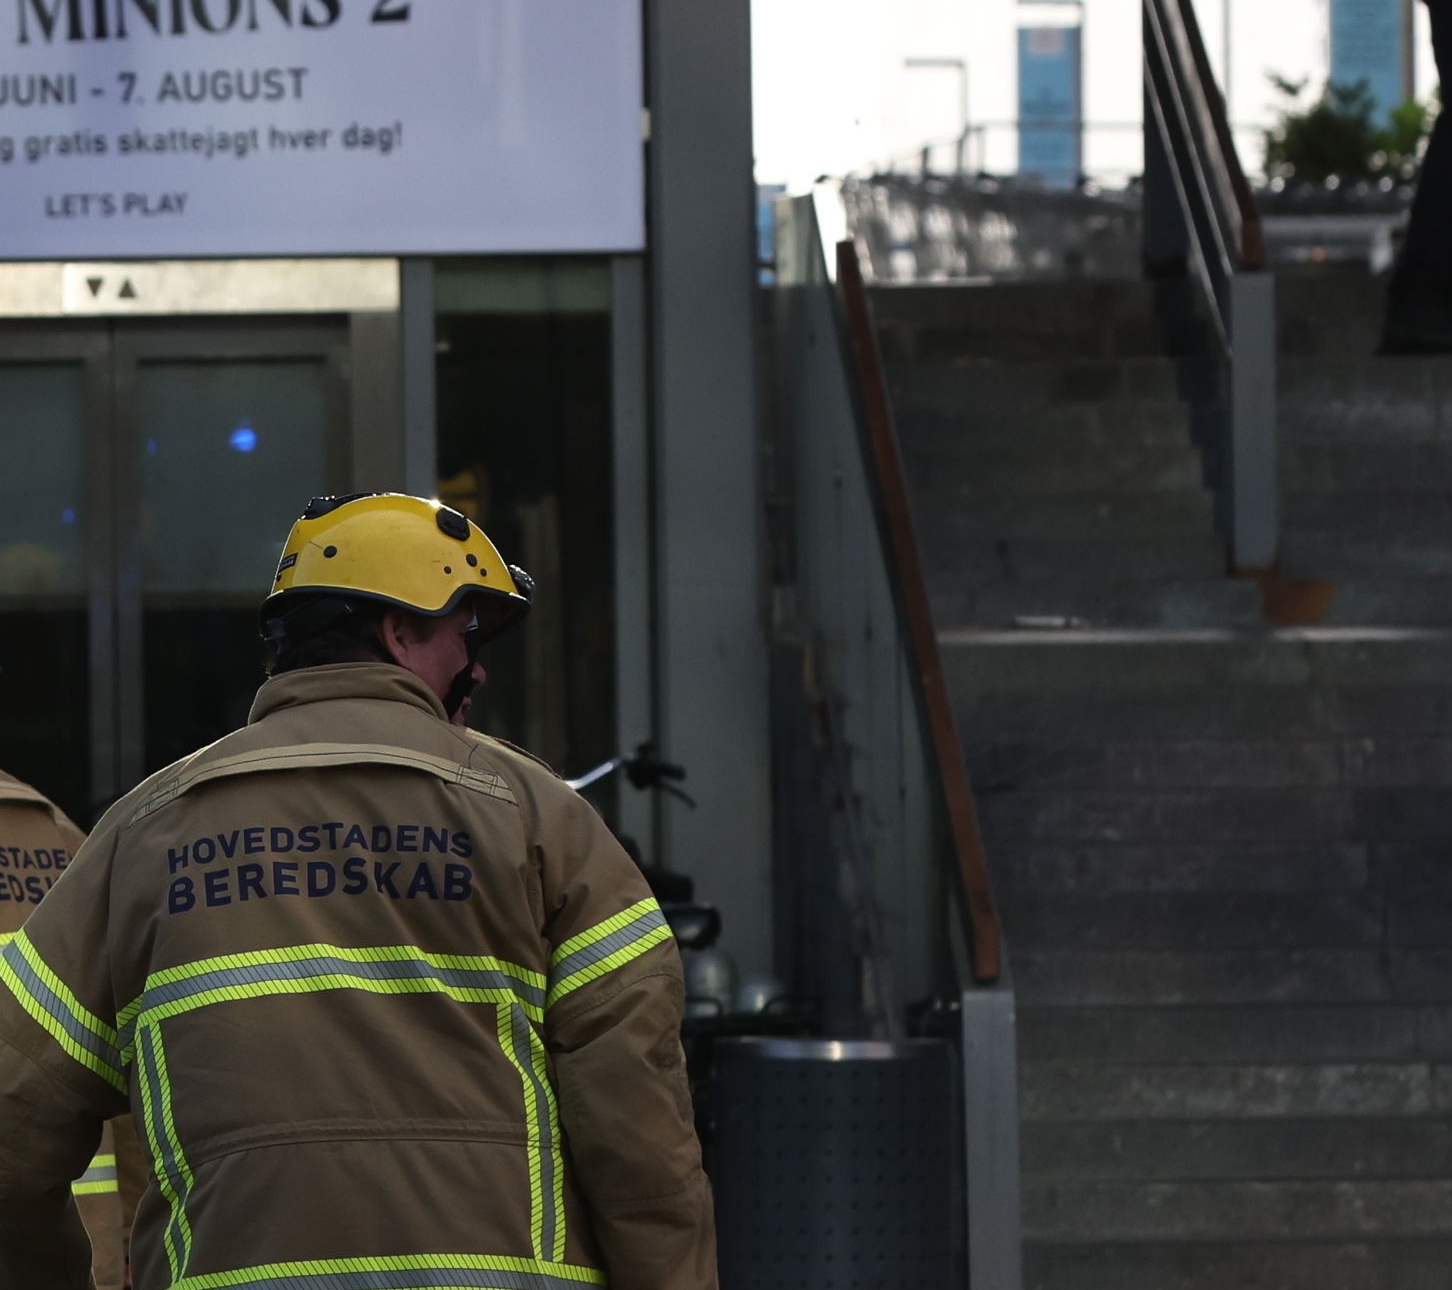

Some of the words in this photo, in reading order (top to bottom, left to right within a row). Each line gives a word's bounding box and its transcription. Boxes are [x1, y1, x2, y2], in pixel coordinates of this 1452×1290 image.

[116, 72, 146, 105] 7.
[157, 67, 310, 103] AUGUST
[24, 130, 110, 163] gratis
[117, 124, 260, 159] skattejagt
[269, 122, 333, 154] hver
[341, 120, 403, 153] dag!
[44, 193, 117, 220] LET'S
[123, 191, 189, 218] PLAY
[167, 822, 473, 875] HOVEDSTADENS
[168, 857, 474, 915] BEREDSKAB
